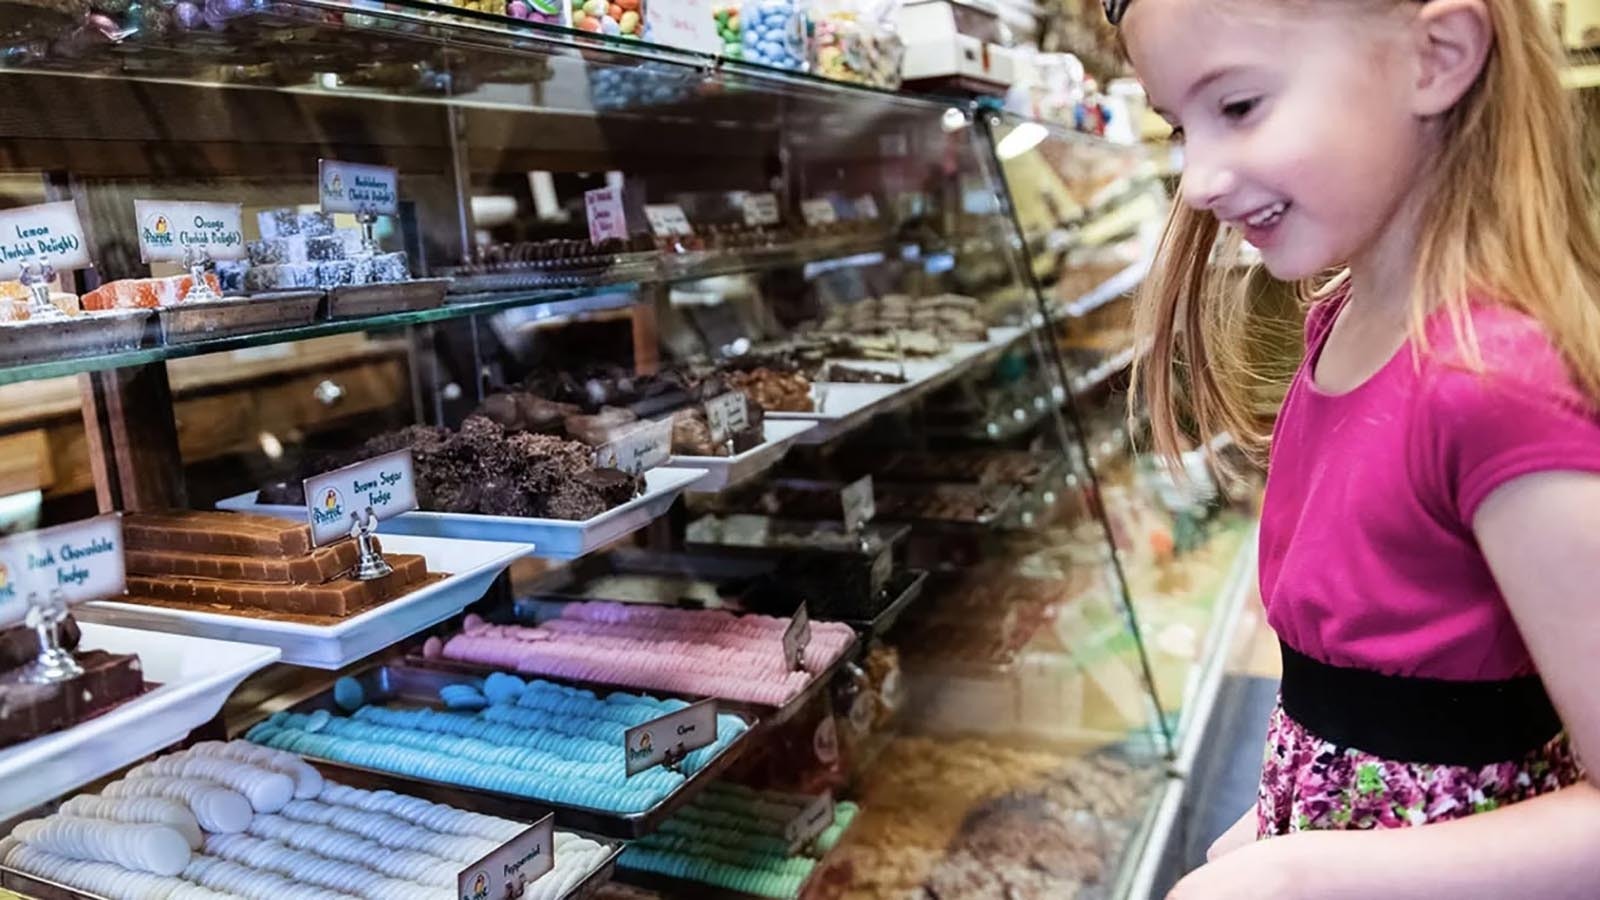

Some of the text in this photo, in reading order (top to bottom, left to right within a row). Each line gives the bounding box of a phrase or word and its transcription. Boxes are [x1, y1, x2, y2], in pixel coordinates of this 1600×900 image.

[16, 224, 49, 239] Lemon
[194, 216, 225, 232] Orange
[38, 233, 79, 255] Delight)
[354, 472, 402, 494] Brown Sugar
[369, 490, 391, 506] Fudge
[61, 537, 113, 561] Chocolate
[58, 565, 89, 585] Fudge
